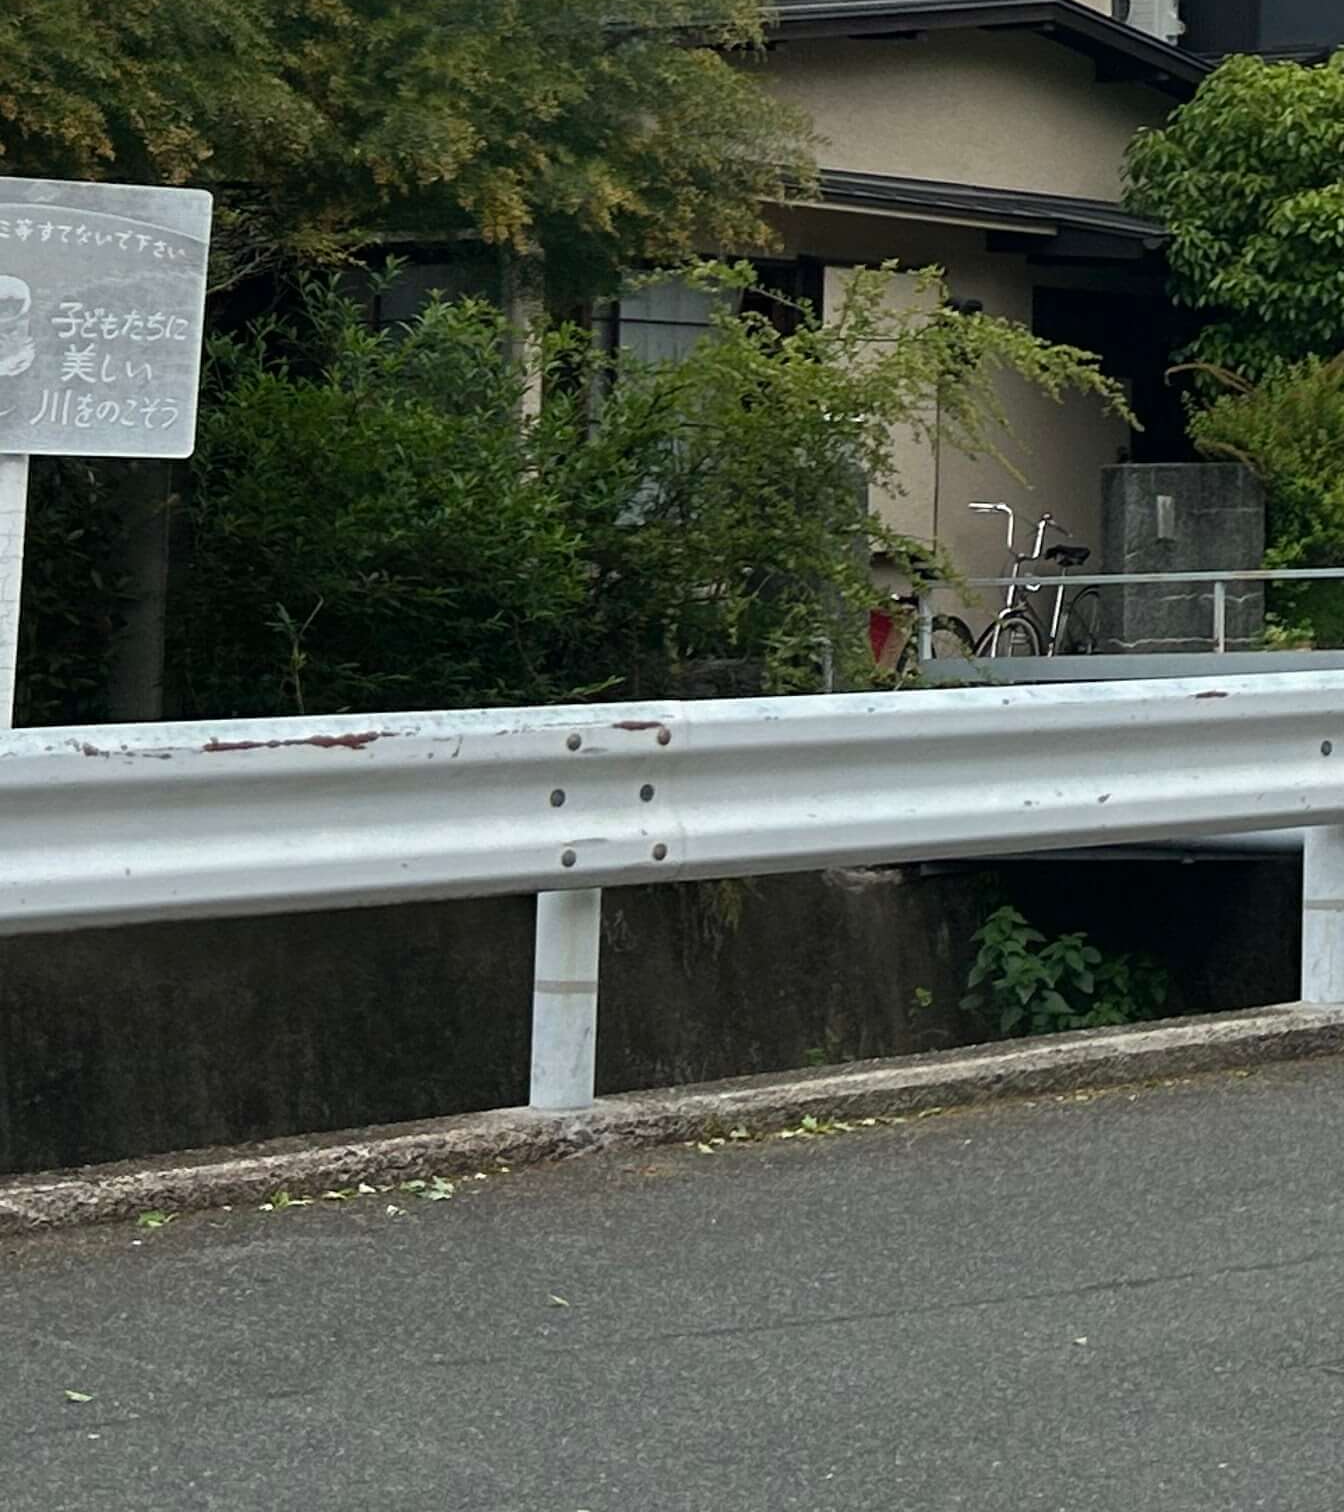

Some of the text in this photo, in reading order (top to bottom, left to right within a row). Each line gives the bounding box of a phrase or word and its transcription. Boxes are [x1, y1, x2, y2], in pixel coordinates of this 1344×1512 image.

[52, 303, 188, 341] 子どもたちに
[61, 344, 153, 383] 美しい
[30, 390, 179, 429] 川をのこそう
